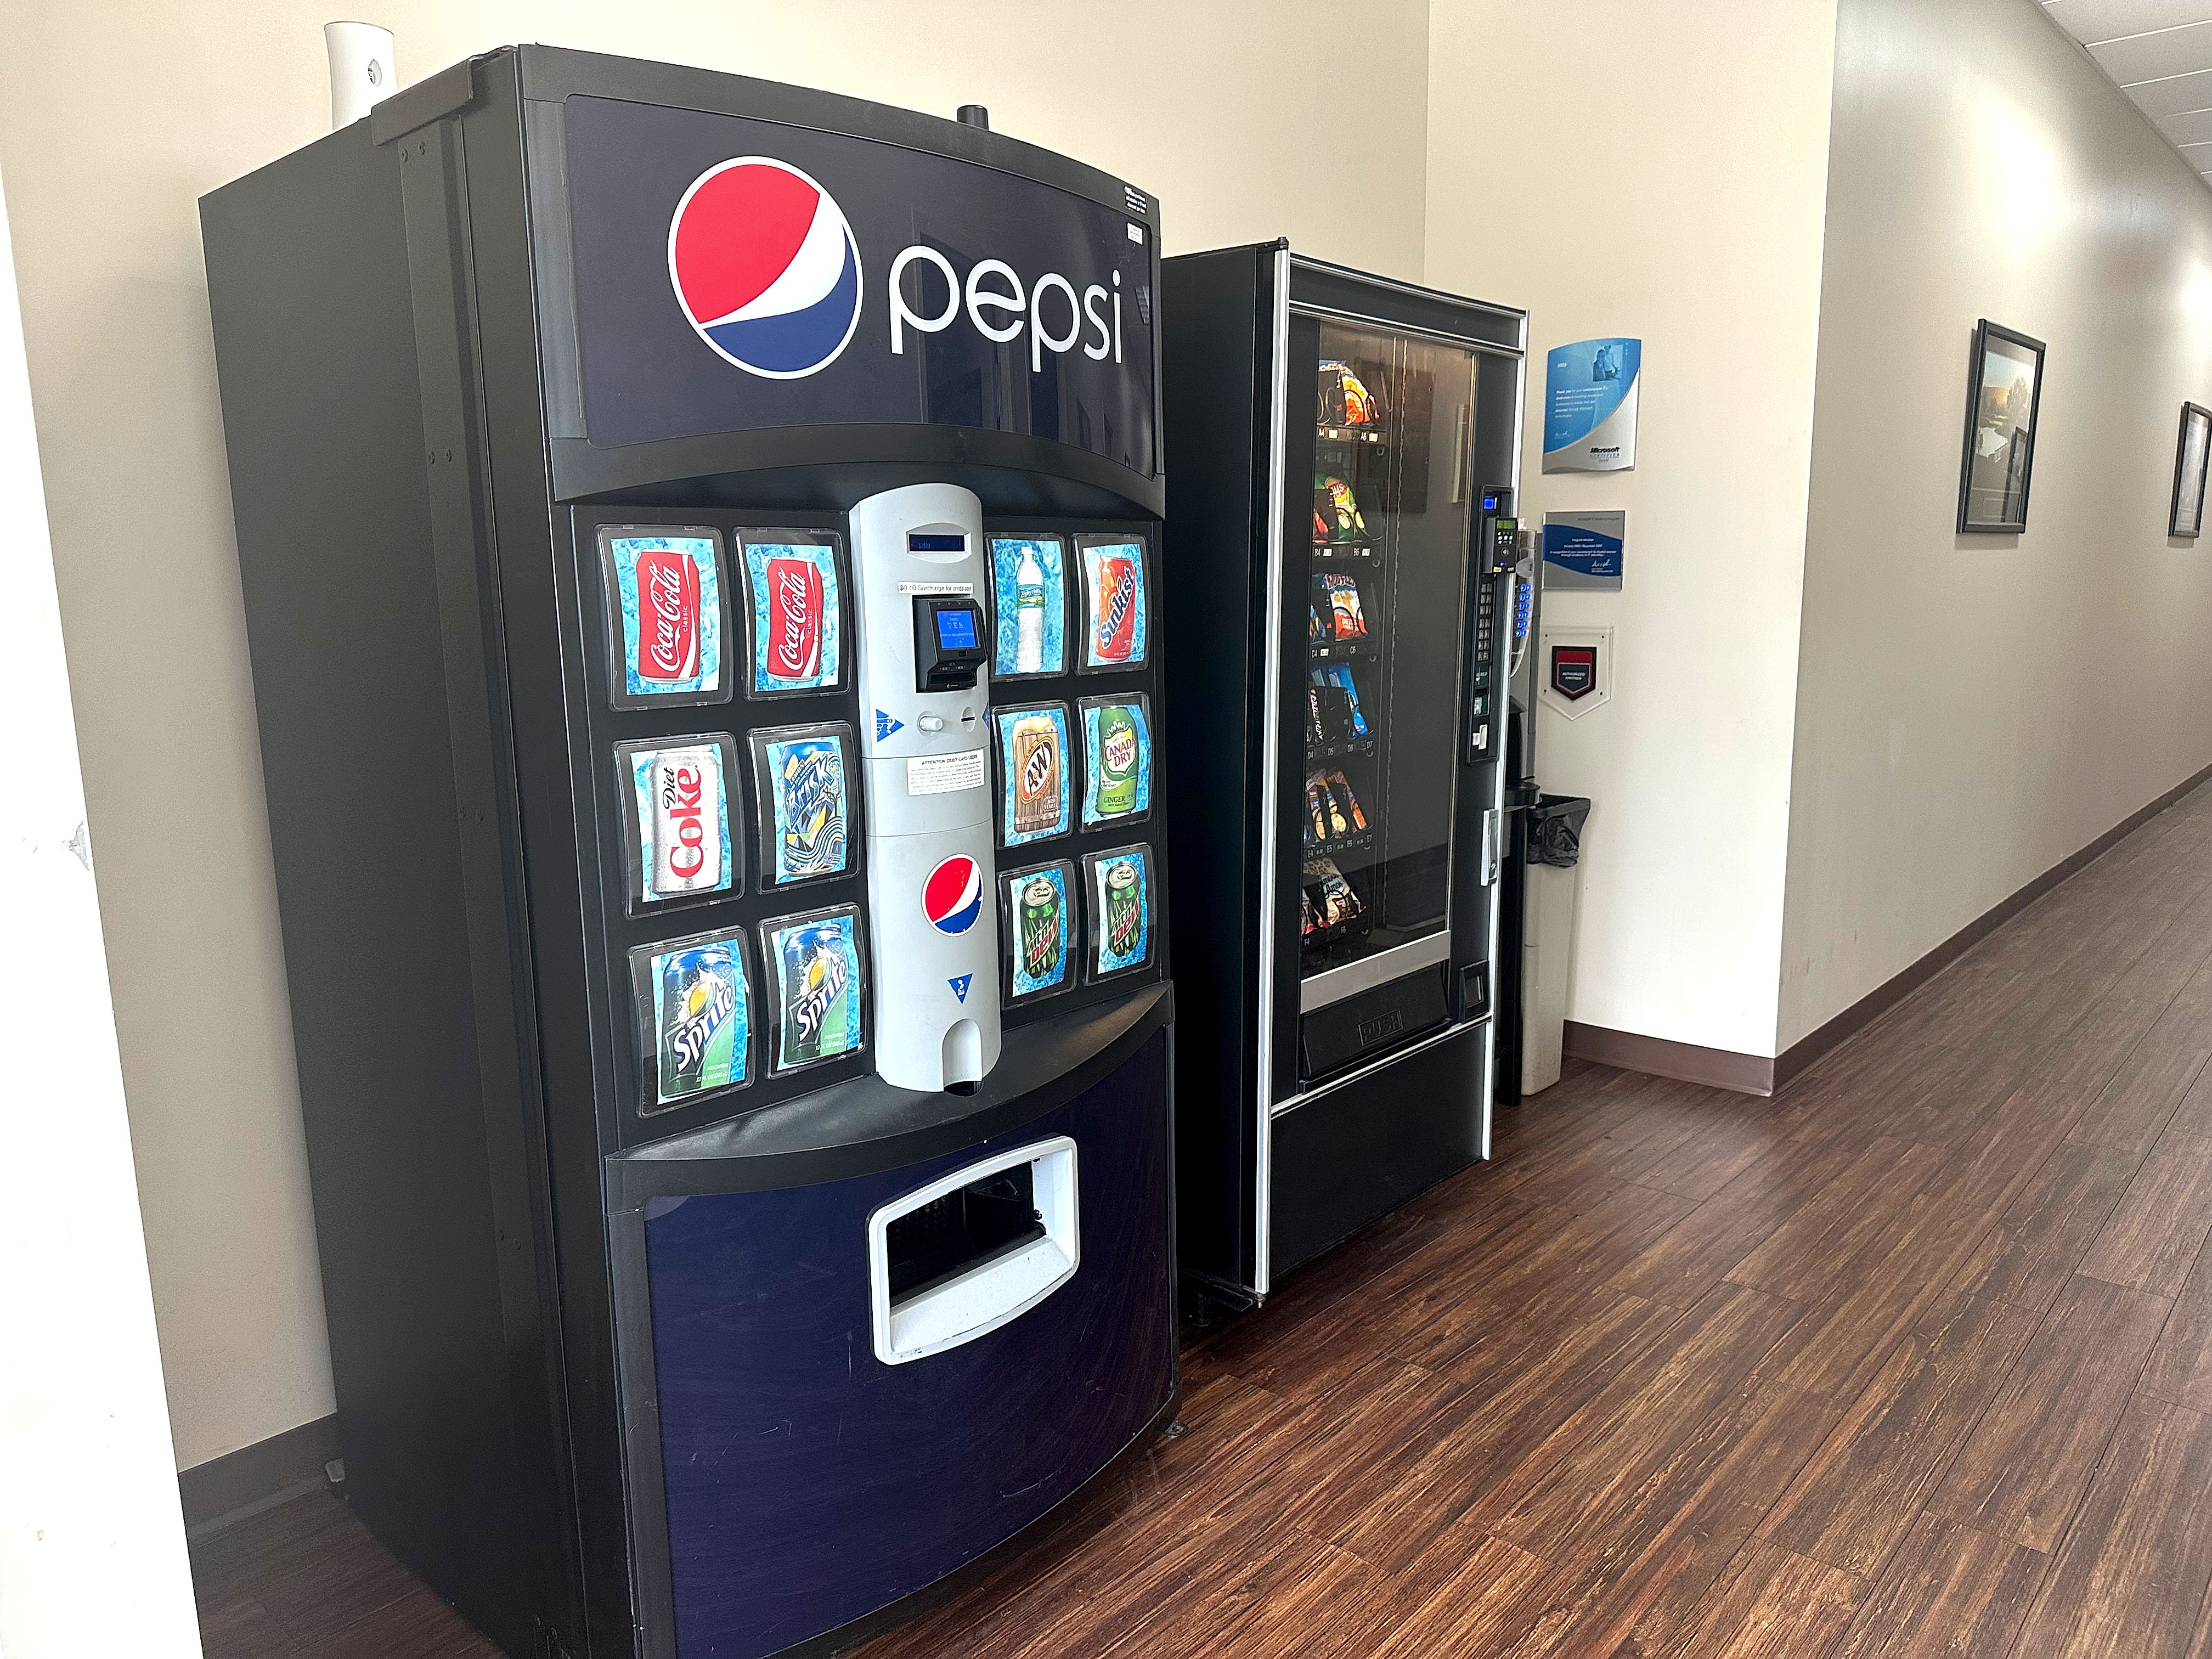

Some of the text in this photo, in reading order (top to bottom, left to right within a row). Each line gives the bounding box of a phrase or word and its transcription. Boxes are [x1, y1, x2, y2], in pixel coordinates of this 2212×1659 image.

[888, 245, 1122, 373] pepsi
[1314, 548, 1321, 557] B4
[900, 584, 916, 592] $010
[917, 584, 945, 593] Surcharge
[1099, 566, 1135, 650] Sunkist
[649, 559, 681, 672] Coca-Cola
[778, 566, 807, 671] Coca-Cola
[1027, 744, 1048, 797] A&W
[1104, 737, 1136, 761] CANADA
[1114, 749, 1131, 767] DRY
[1307, 751, 1314, 760] D4
[662, 766, 676, 810] Diet
[669, 768, 704, 878] Coke
[1307, 849, 1313, 858] E4
[796, 956, 848, 1042] Sprite
[674, 981, 734, 1073] Sprite
